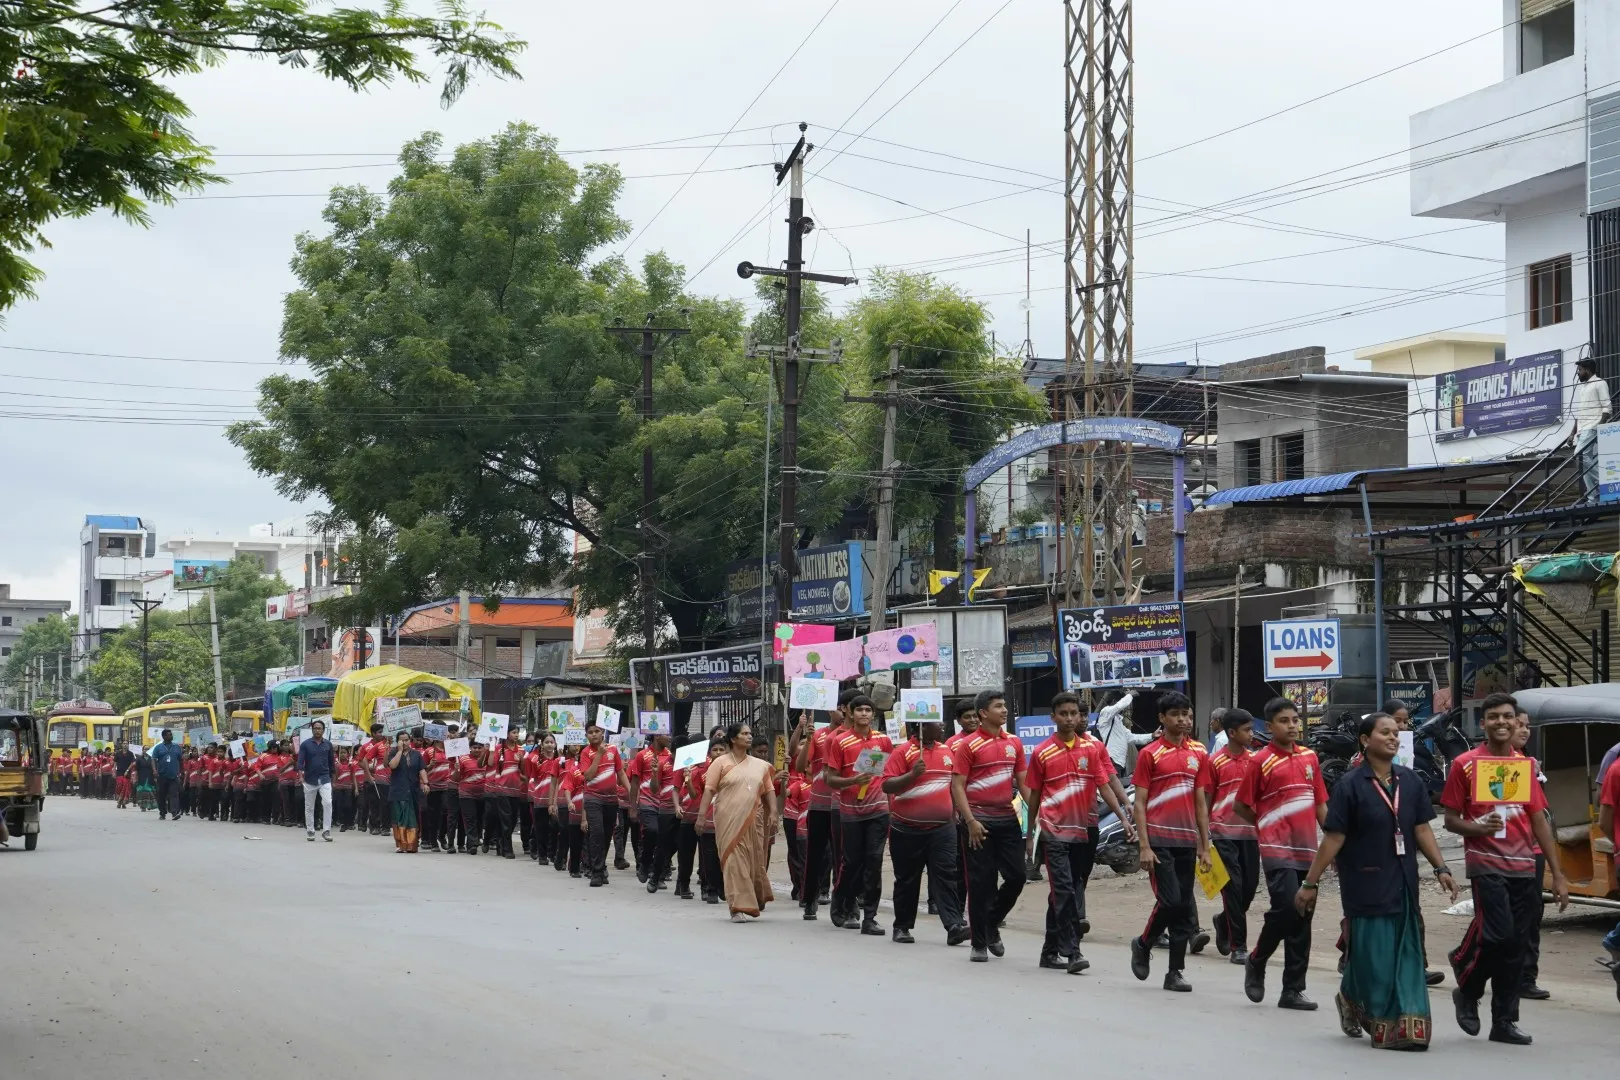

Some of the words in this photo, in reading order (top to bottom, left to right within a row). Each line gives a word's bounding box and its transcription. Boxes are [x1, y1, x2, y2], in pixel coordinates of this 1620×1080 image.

[1467, 372, 1508, 404] FRIENDS
[1510, 363, 1558, 396] MOBILES
[827, 549, 848, 578] MESS
[797, 589, 807, 600] VEG,
[1091, 643, 1114, 653] FRIENDS
[1114, 641, 1137, 651] MOBILE
[1138, 640, 1161, 650] SERVICE
[1270, 627, 1335, 650] LOANS
[669, 655, 729, 676] కాకతీయ
[732, 653, 759, 673] మెస్
[1391, 689, 1426, 699] LUMINOUS
